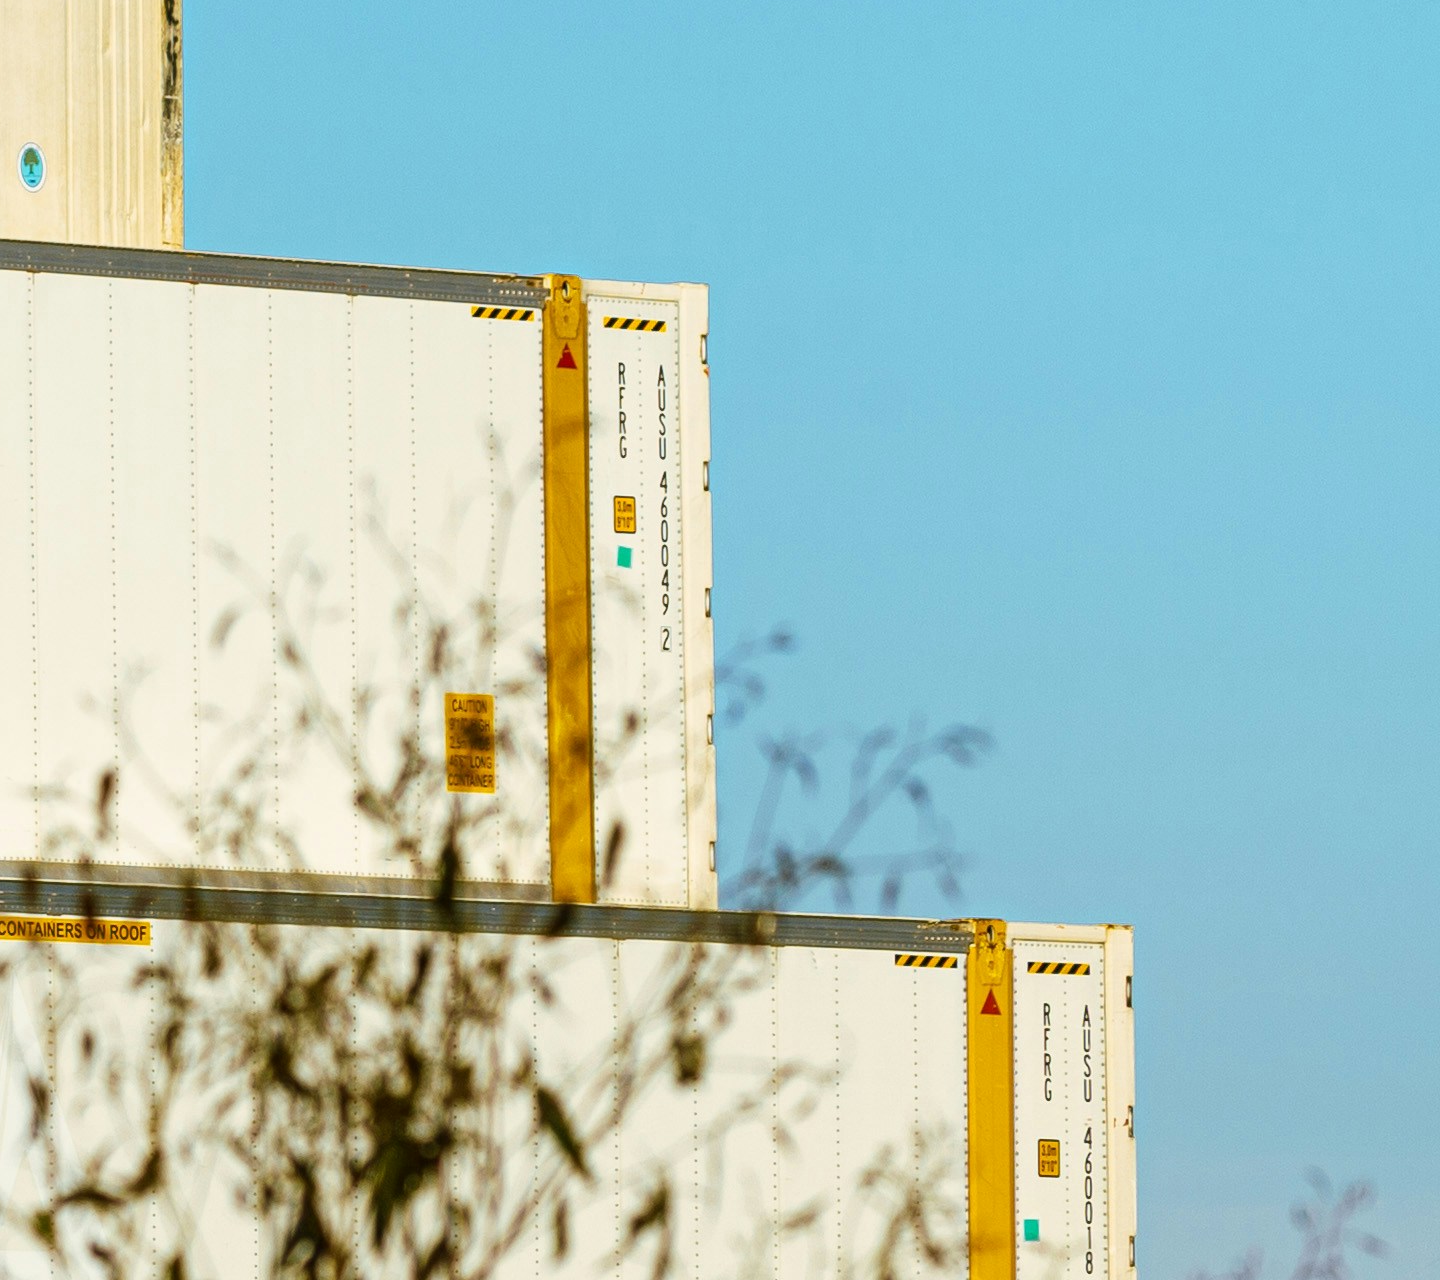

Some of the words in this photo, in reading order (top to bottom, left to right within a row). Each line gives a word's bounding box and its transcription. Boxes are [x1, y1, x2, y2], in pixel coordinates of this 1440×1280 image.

[618, 362, 627, 459] RFRG
[657, 365, 667, 460] AUSU
[660, 471, 669, 615] 460049
[662, 628, 670, 651] 2
[86, 923, 106, 940] ON
[110, 924, 148, 941] ROOF
[1043, 1003, 1053, 1101] RFRG
[1082, 1004, 1093, 1102] AUSU
[1084, 1126, 1093, 1274] 460018
